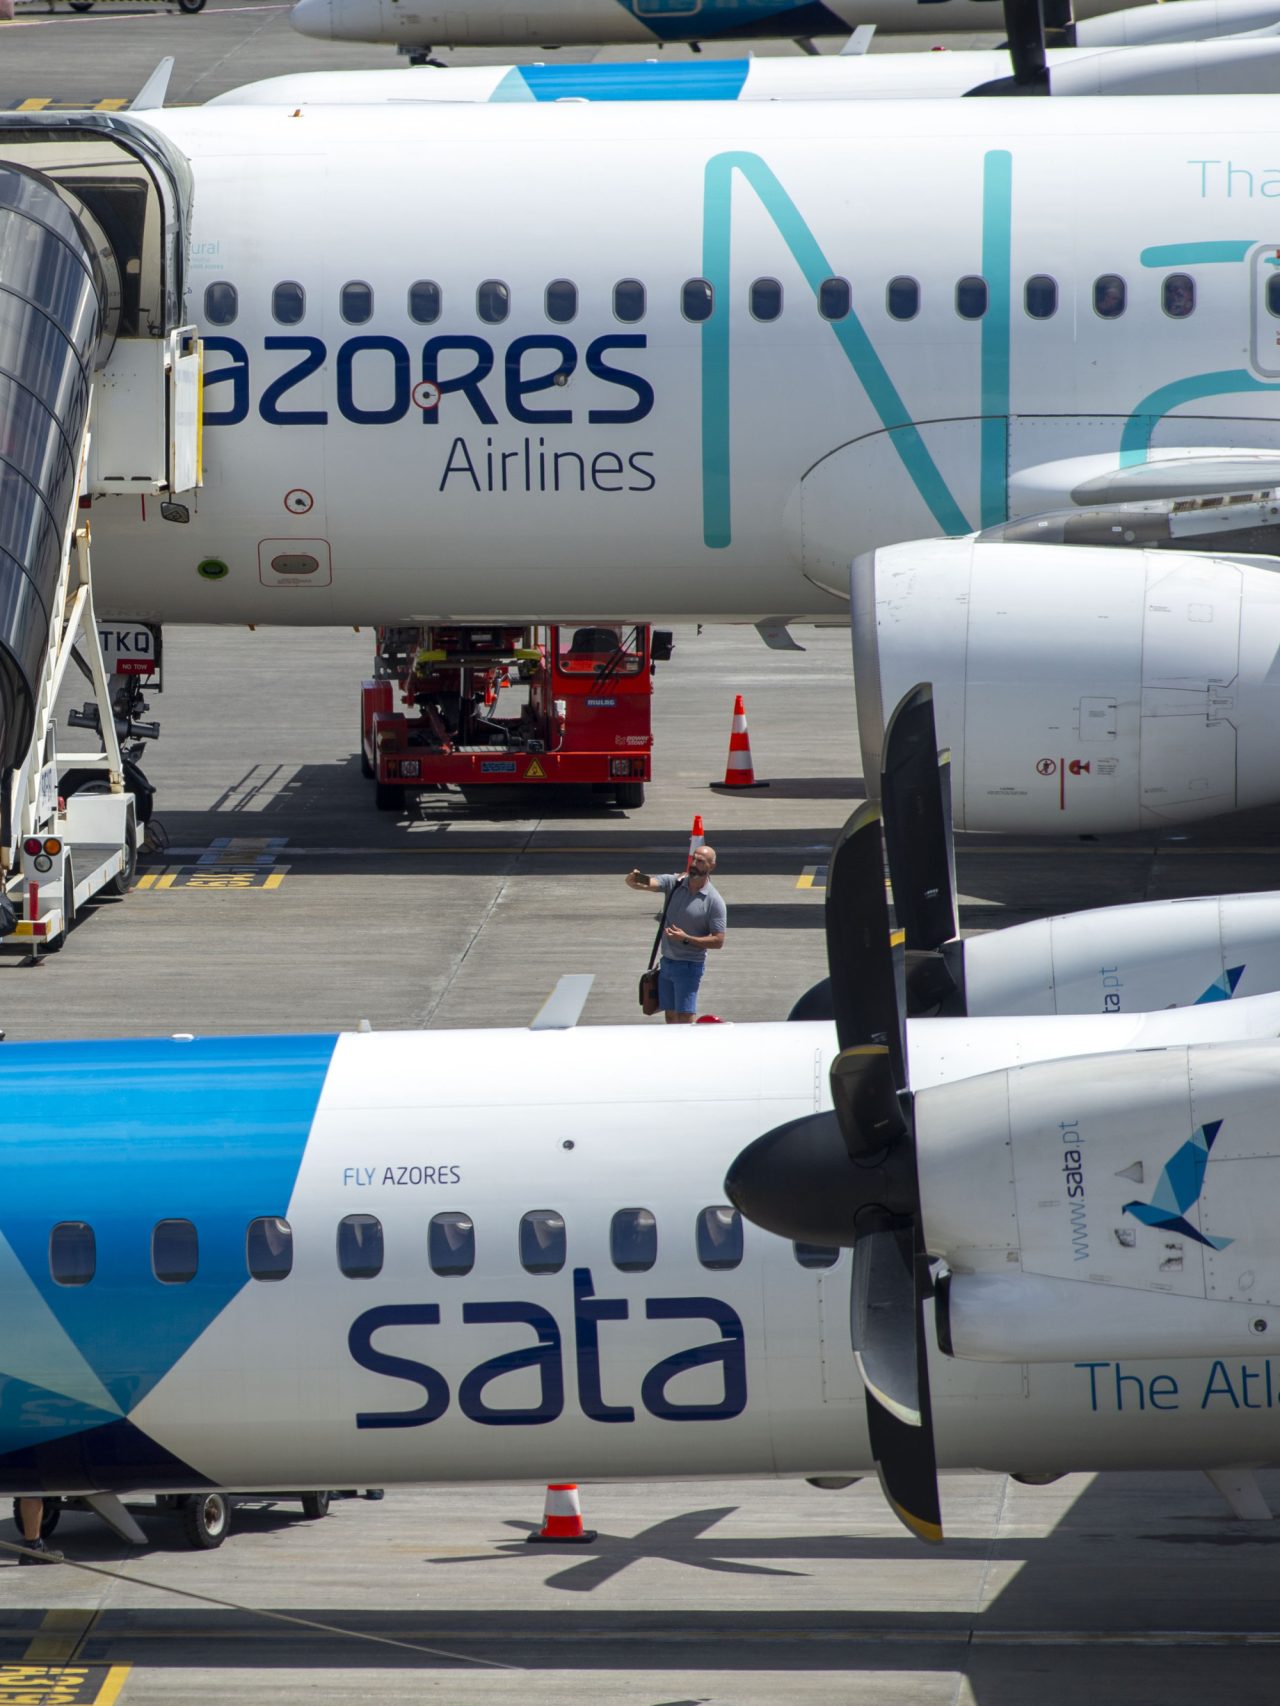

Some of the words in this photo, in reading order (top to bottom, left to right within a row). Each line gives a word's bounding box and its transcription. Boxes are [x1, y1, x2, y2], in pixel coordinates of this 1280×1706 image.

[183, 334, 655, 426] azores
[439, 437, 657, 493] Airlines
[99, 631, 150, 653] TKQ
[343, 1167, 376, 1186] FLY
[382, 1164, 461, 1186] AZORES
[1058, 1119, 1090, 1262] www.sata.pt
[348, 1267, 747, 1430] sata
[1074, 1361, 1179, 1411] The
[1201, 1359, 1280, 1409] Atl
